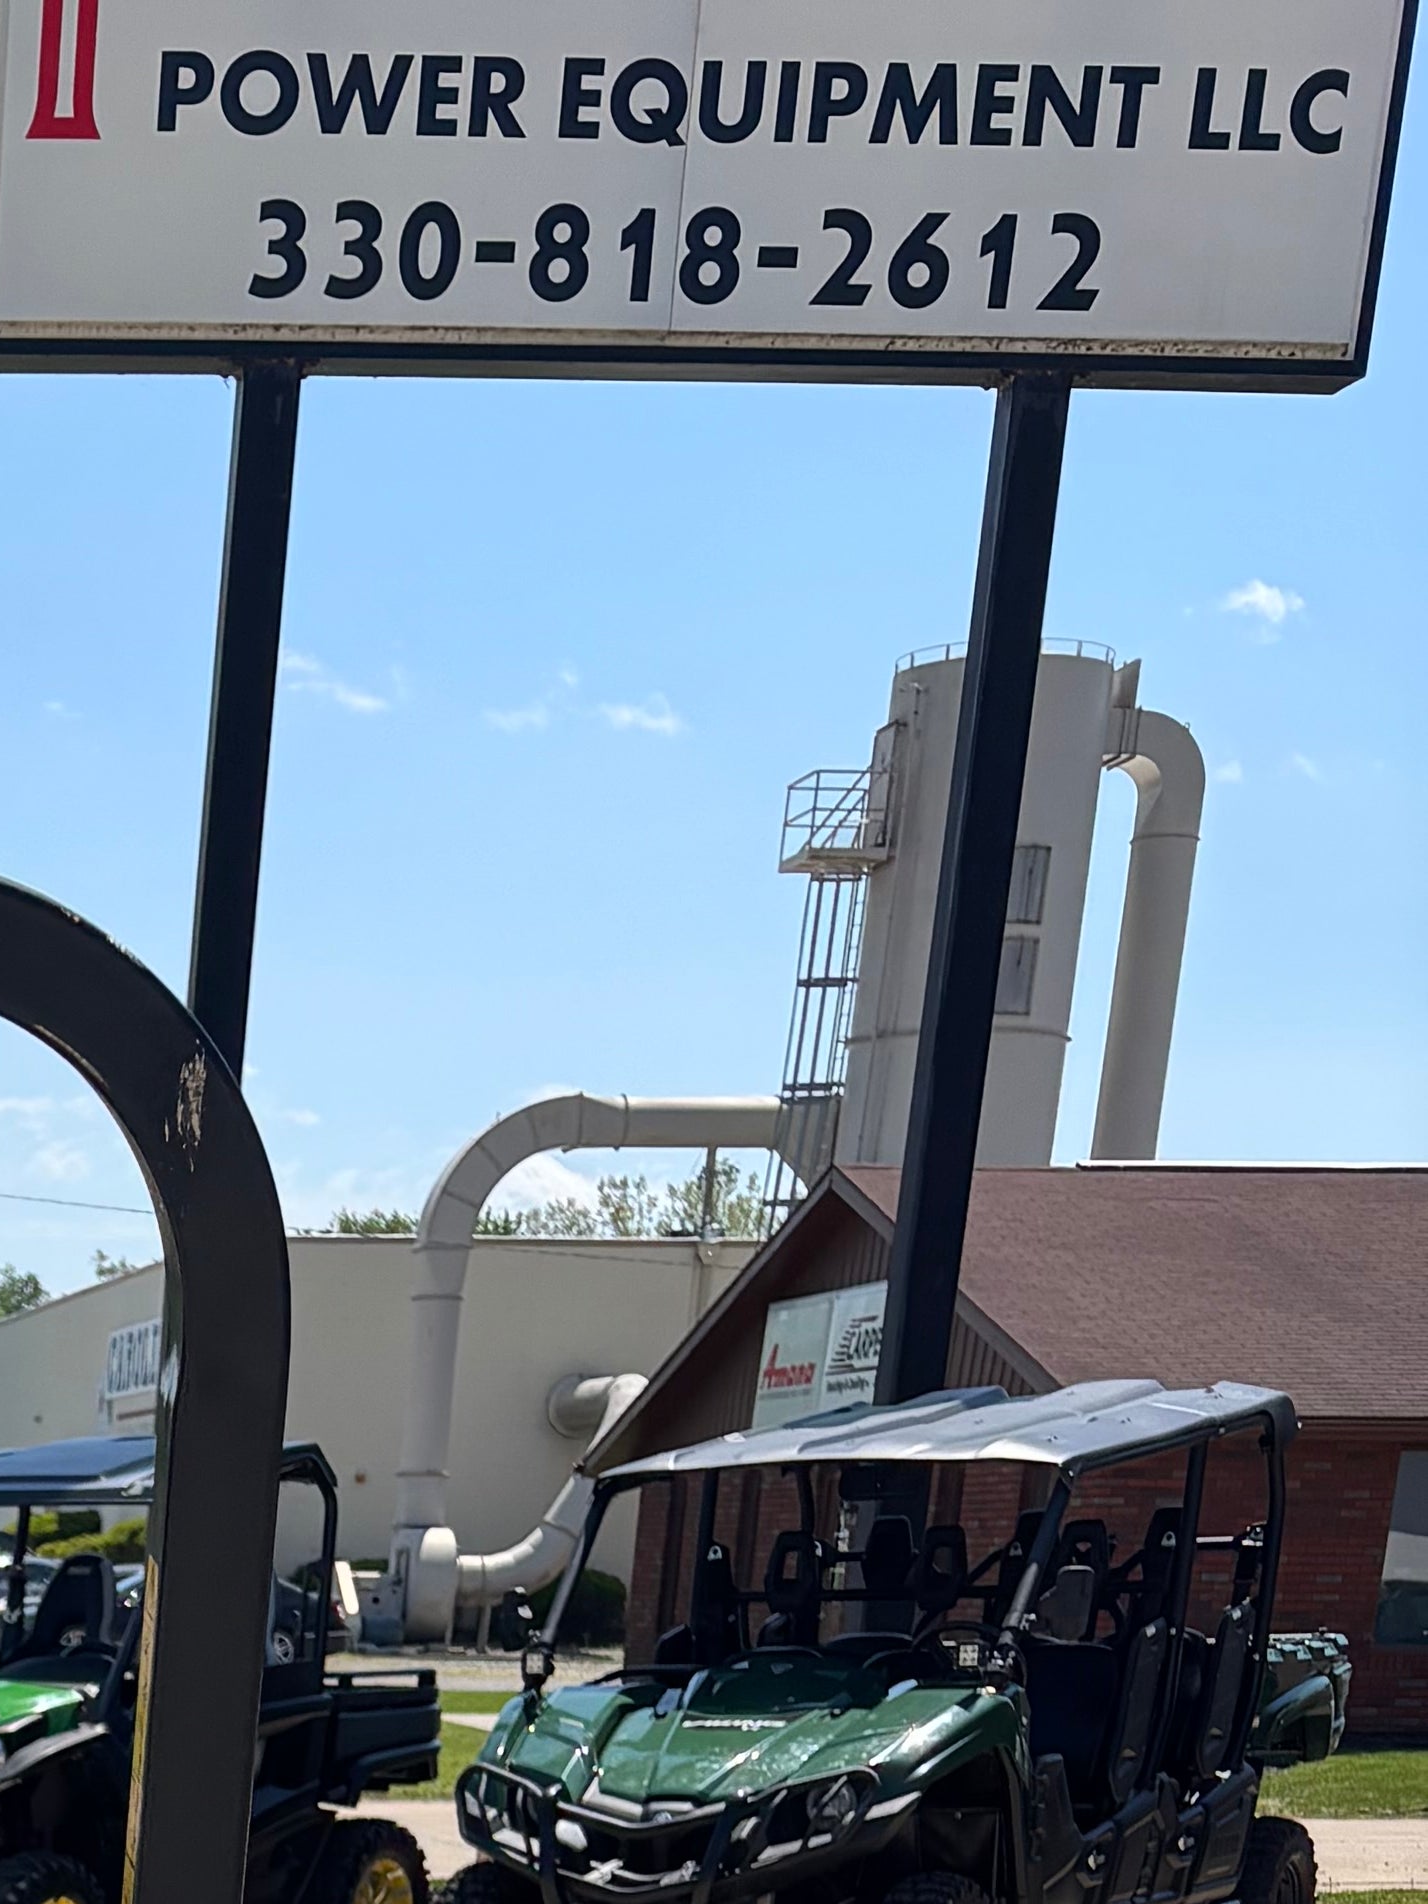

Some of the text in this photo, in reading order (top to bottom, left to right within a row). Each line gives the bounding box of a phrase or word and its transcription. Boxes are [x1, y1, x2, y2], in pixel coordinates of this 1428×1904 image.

[156, 49, 527, 138] POWER
[557, 57, 1160, 147] EQUIPMENT
[1187, 68, 1350, 154] LLC
[248, 198, 1101, 311] 330-818-2612
